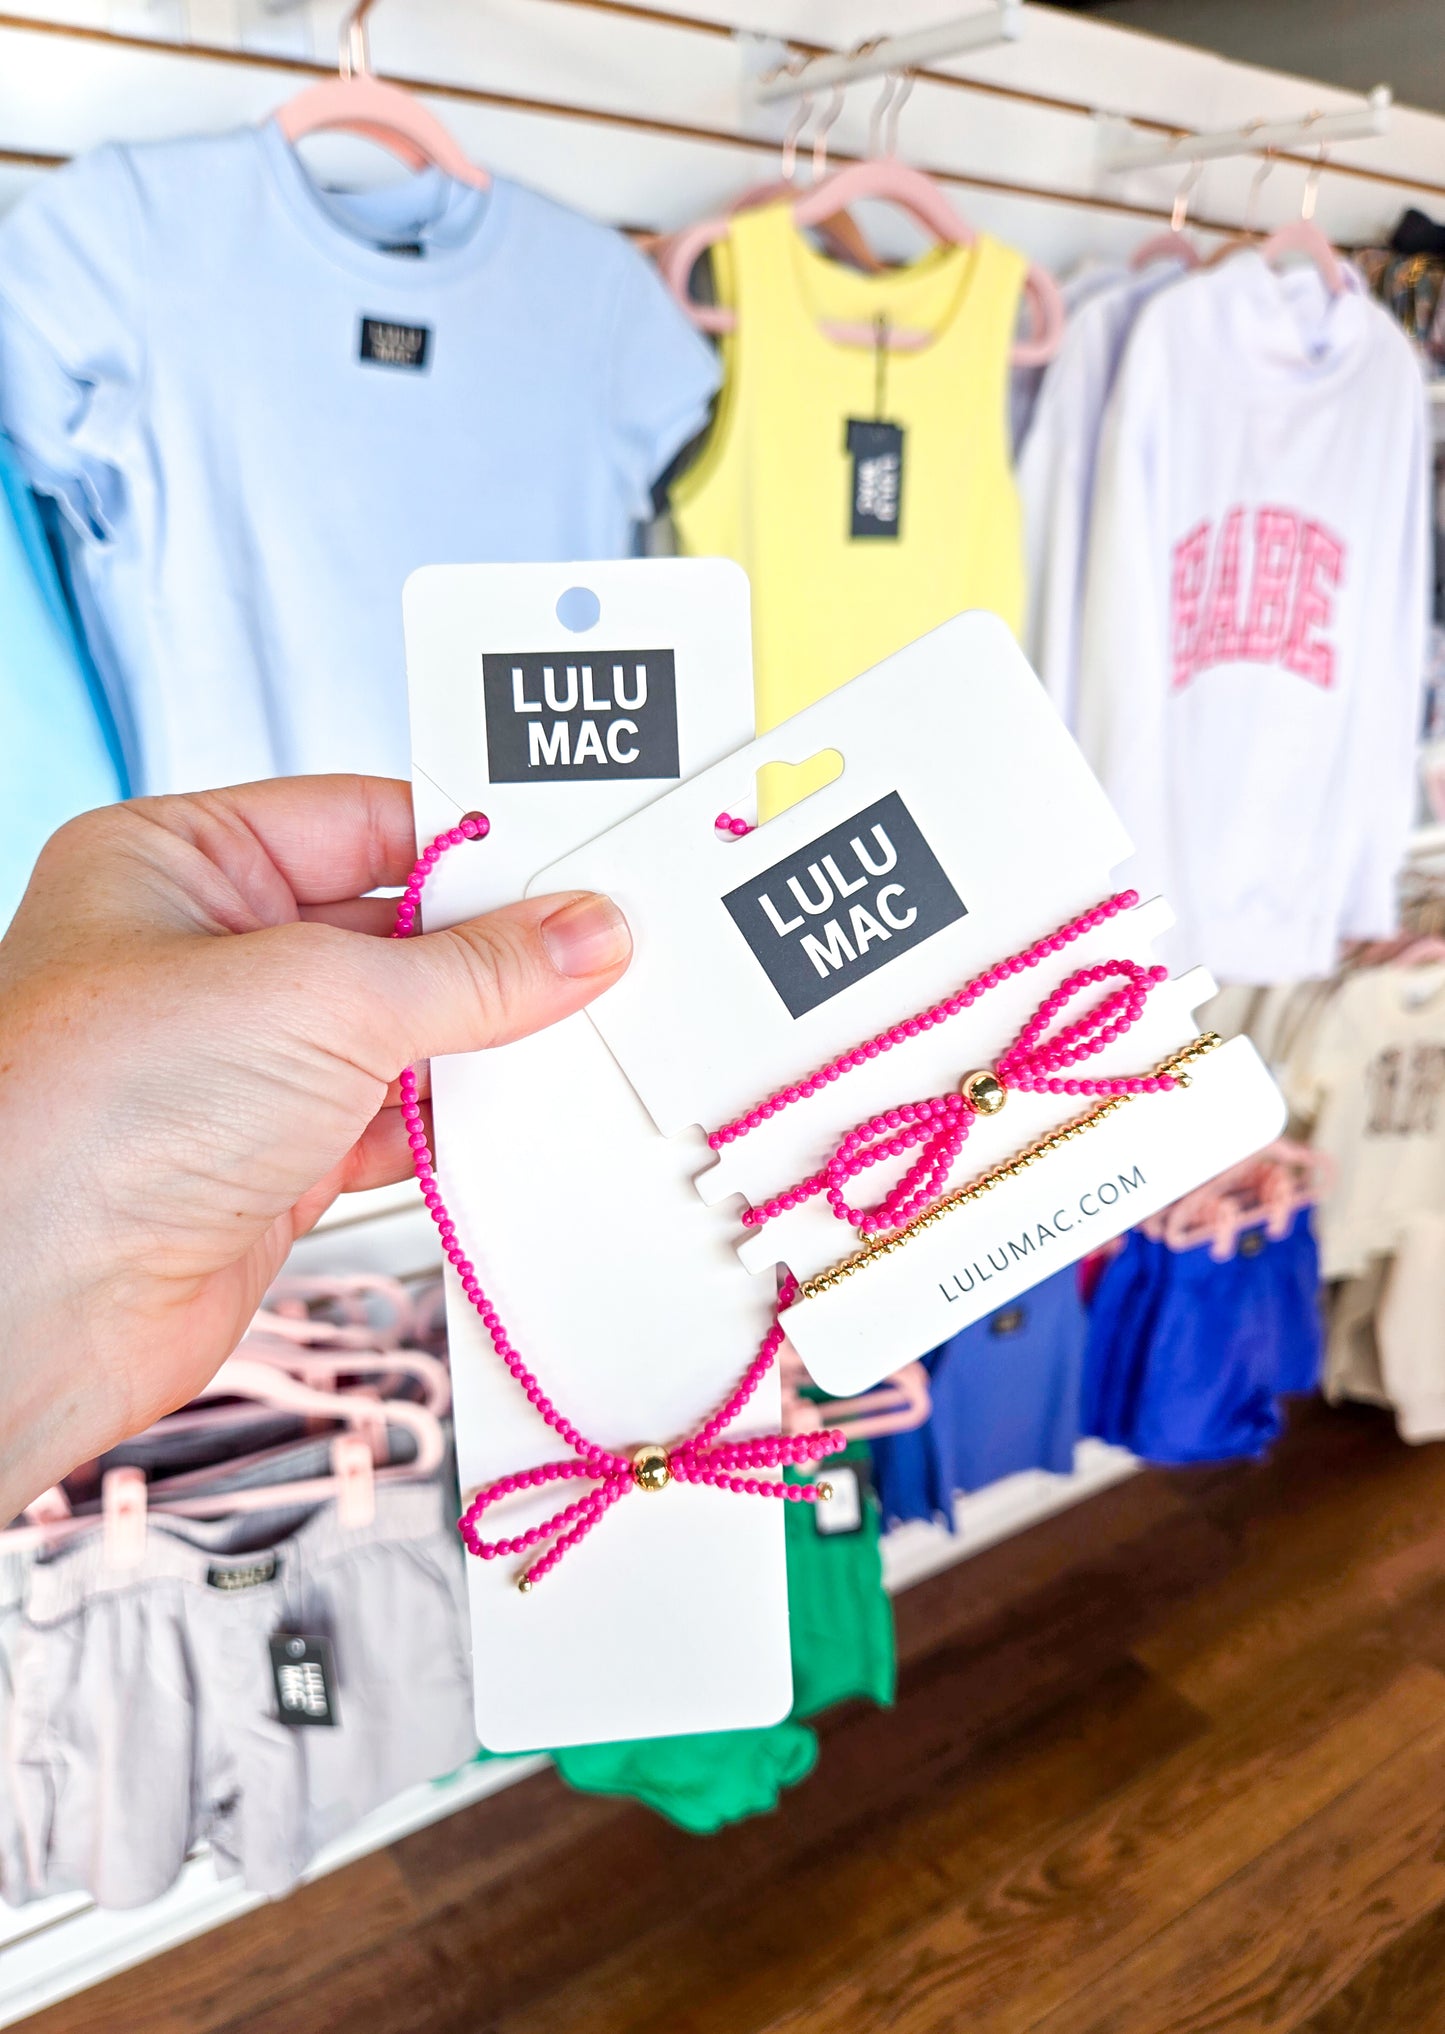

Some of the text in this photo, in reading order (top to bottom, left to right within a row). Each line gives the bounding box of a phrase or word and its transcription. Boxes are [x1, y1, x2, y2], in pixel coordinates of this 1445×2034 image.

[1172, 505, 1344, 692] BABE
[511, 664, 648, 713] LULU
[528, 718, 641, 766] MAC
[757, 823, 898, 938] LULU
[799, 883, 918, 979] MAC
[938, 1165, 1147, 1302] LULUMAC.COM
